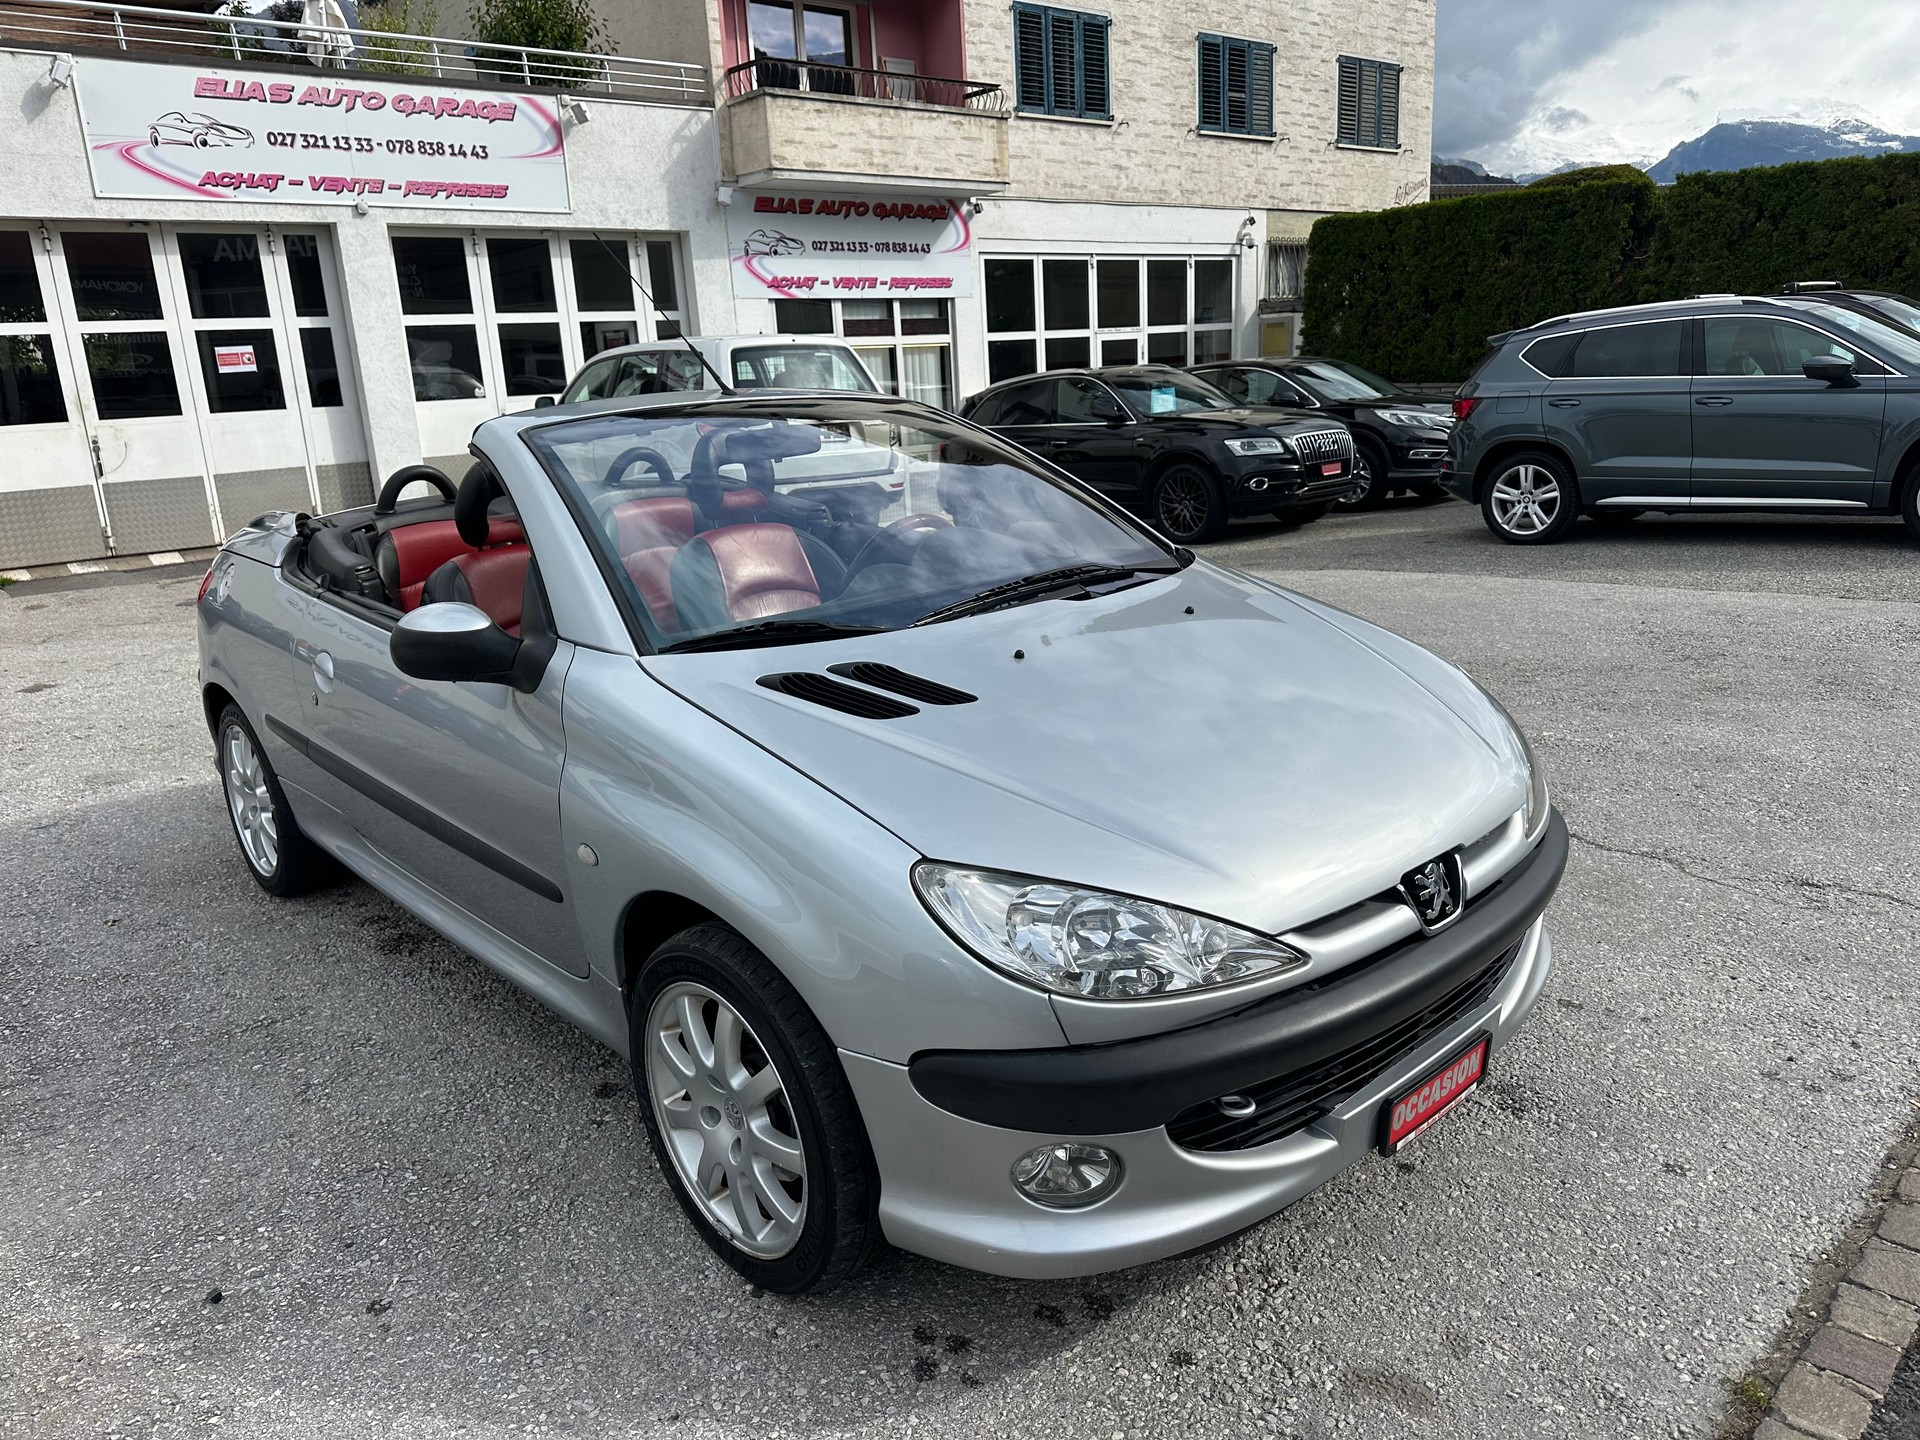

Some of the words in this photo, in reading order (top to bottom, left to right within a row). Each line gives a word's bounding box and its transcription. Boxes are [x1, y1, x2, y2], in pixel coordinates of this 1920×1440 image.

[193, 77, 294, 103] ELIAS
[297, 85, 387, 113] AUTO
[391, 94, 517, 124] GARAGE
[266, 131, 296, 148] 027
[299, 133, 330, 149] 321
[333, 136, 351, 151] 13
[354, 137, 374, 153] 33
[386, 139, 414, 155] 078
[417, 141, 445, 156] 838
[448, 144, 467, 158] 14
[470, 145, 488, 160] 43
[198, 171, 284, 193] ACHAT
[308, 176, 384, 196] VENTE
[403, 180, 509, 199] REPRISES
[754, 196, 814, 214] ELIAS
[815, 199, 869, 220] AUTO
[872, 202, 950, 223] GARAGE
[812, 241, 828, 251] 027
[829, 241, 845, 252] 321
[847, 242, 857, 252] 13
[858, 242, 869, 253] 33
[874, 242, 890, 253] 078
[892, 242, 907, 253] 838
[908, 243, 919, 255] 14
[920, 243, 931, 254] 43
[767, 276, 818, 291] ACHAT
[832, 277, 878, 291] VENTE
[888, 277, 953, 291] REPRISES
[1392, 1047, 1482, 1132] OCCASION
